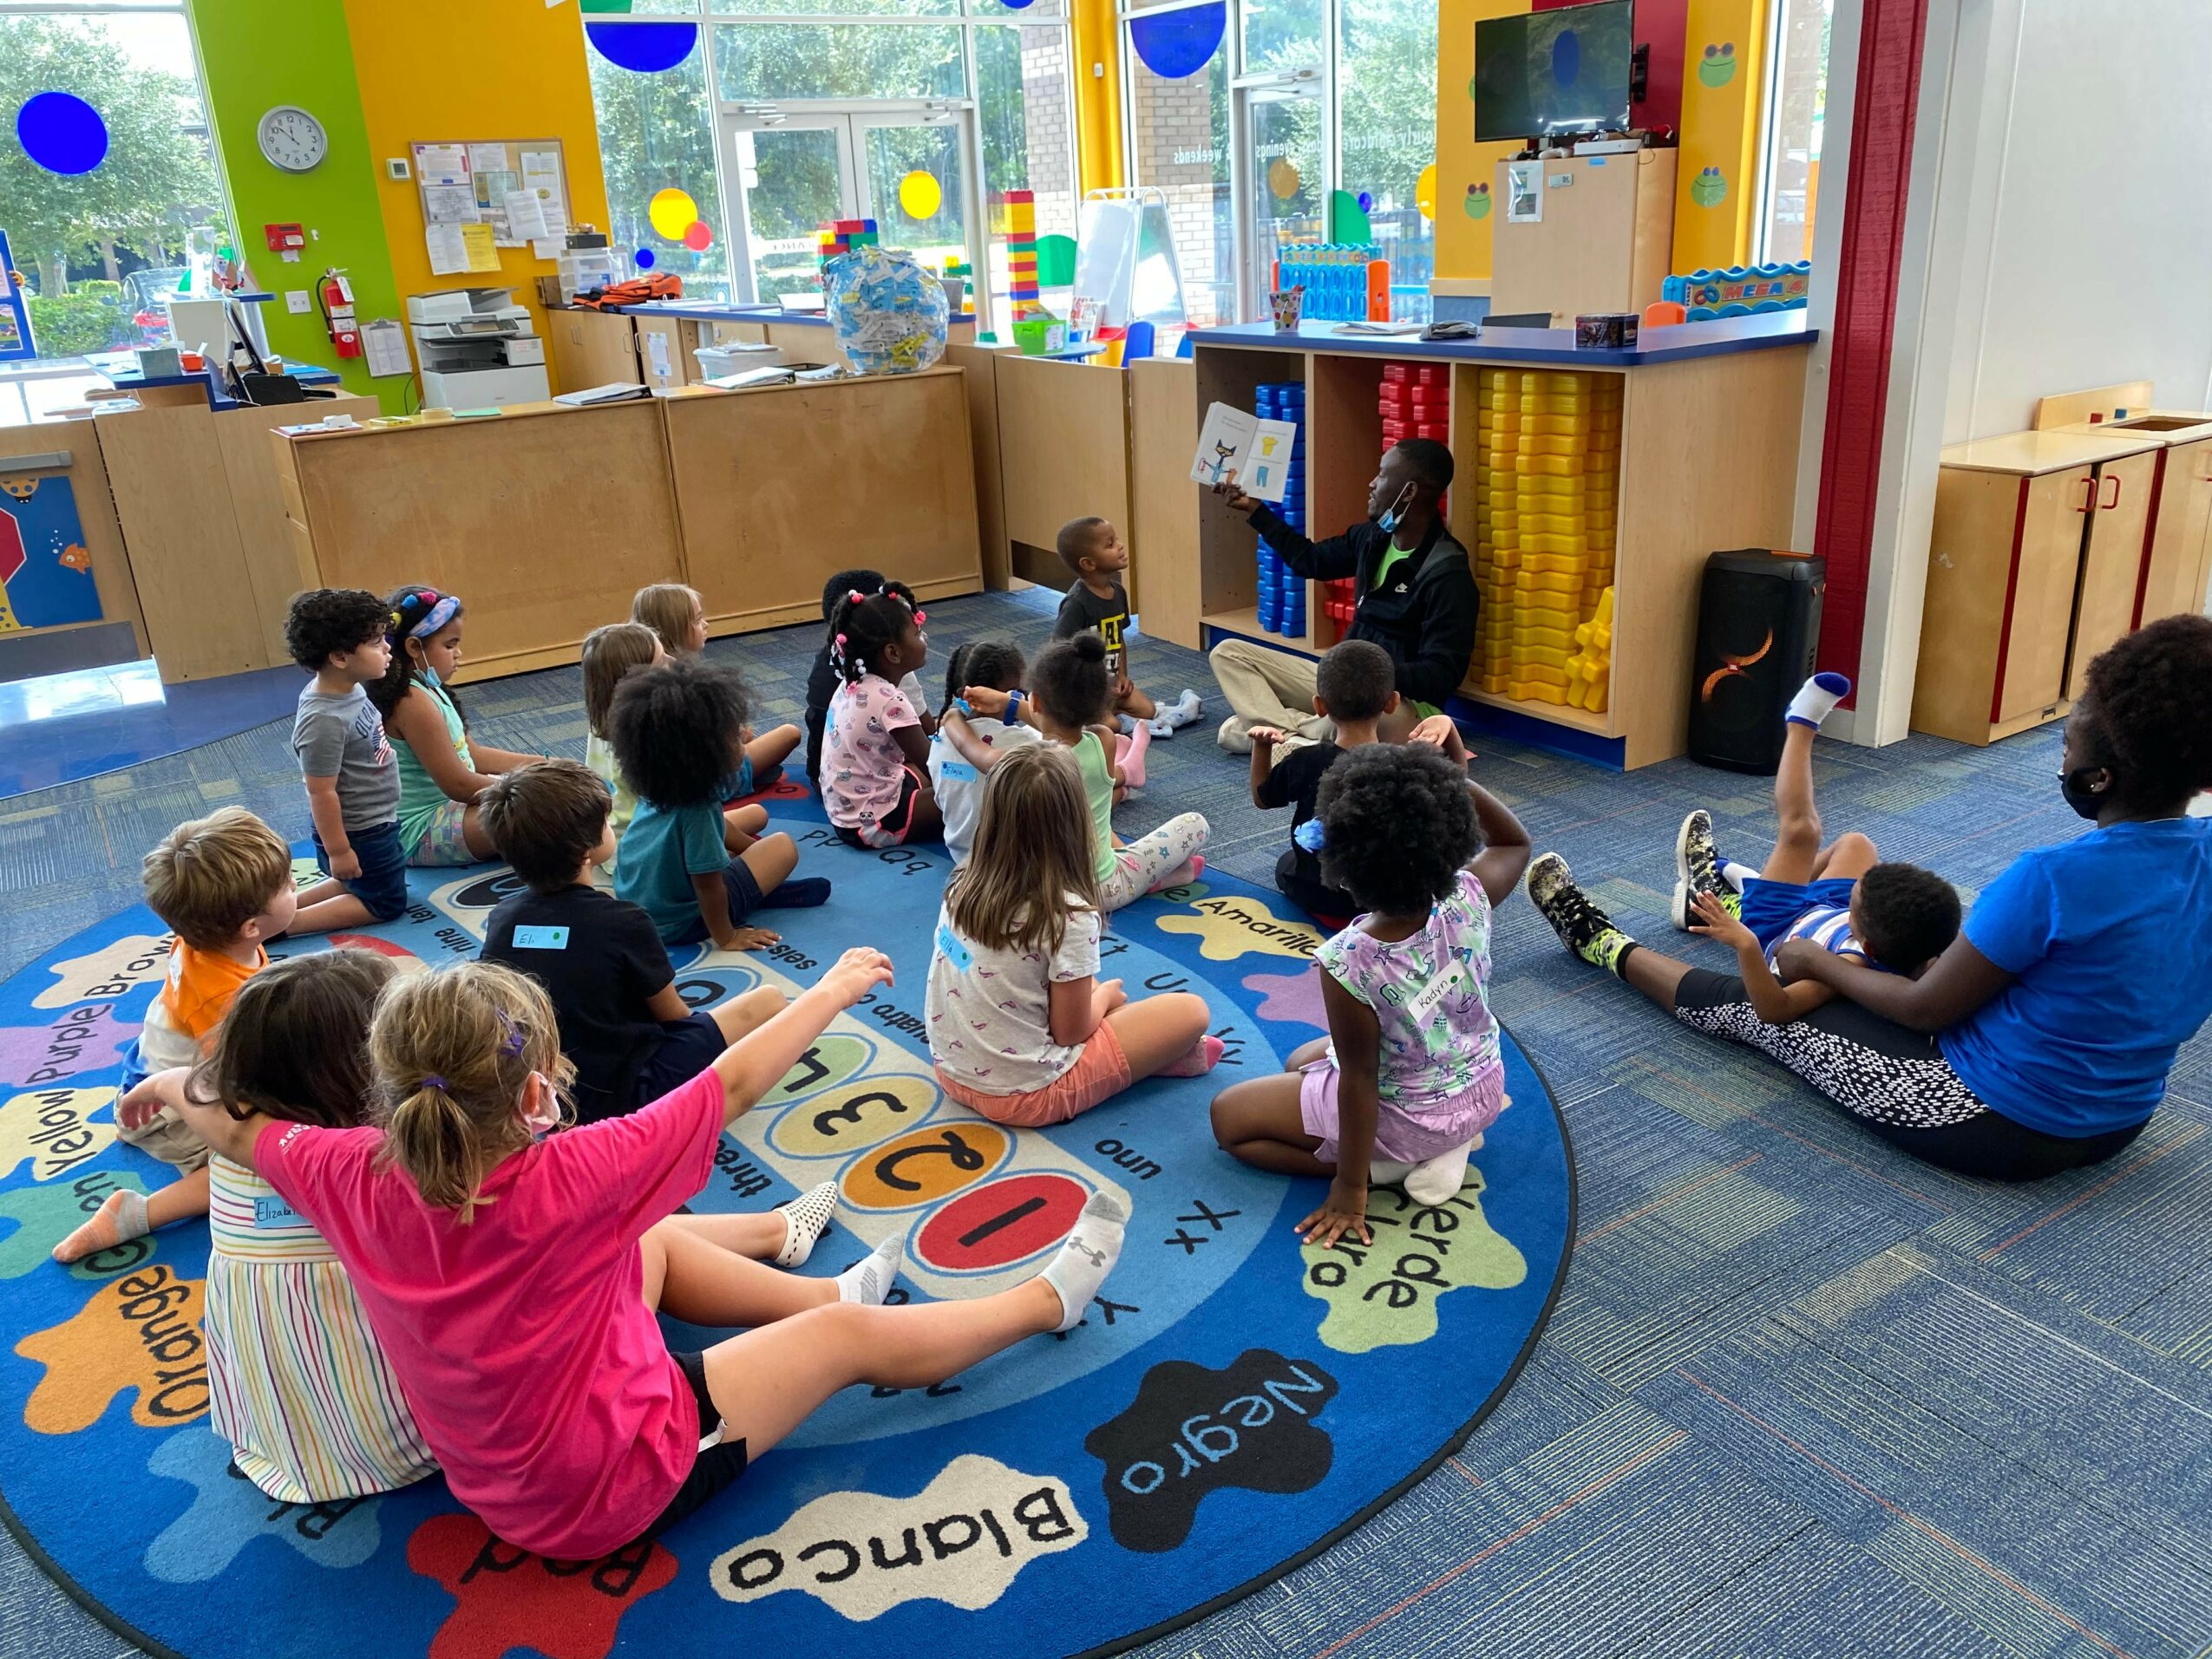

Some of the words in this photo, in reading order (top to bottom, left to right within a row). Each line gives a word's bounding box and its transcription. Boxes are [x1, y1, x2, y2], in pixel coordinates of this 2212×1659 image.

[1722, 282, 1784, 301] MEGA
[1788, 278, 1806, 294] 4
[406, 904, 436, 924] ten
[434, 928, 477, 953] nine
[84, 934, 175, 996] Brow
[768, 944, 818, 970] seis
[1418, 978, 1450, 1009] Kadyn
[25, 1004, 113, 1084] Purple
[28, 1090, 97, 1176] Yellow
[813, 1091, 908, 1136] 3
[874, 1130, 985, 1192] 2
[1095, 1139, 1162, 1180] uno
[957, 1196, 1048, 1248] 1
[1163, 1199, 1242, 1255] Xx
[119, 1266, 211, 1417] Orange
[1122, 1365, 1324, 1495] Negro
[729, 1486, 1076, 1590] Blanco
